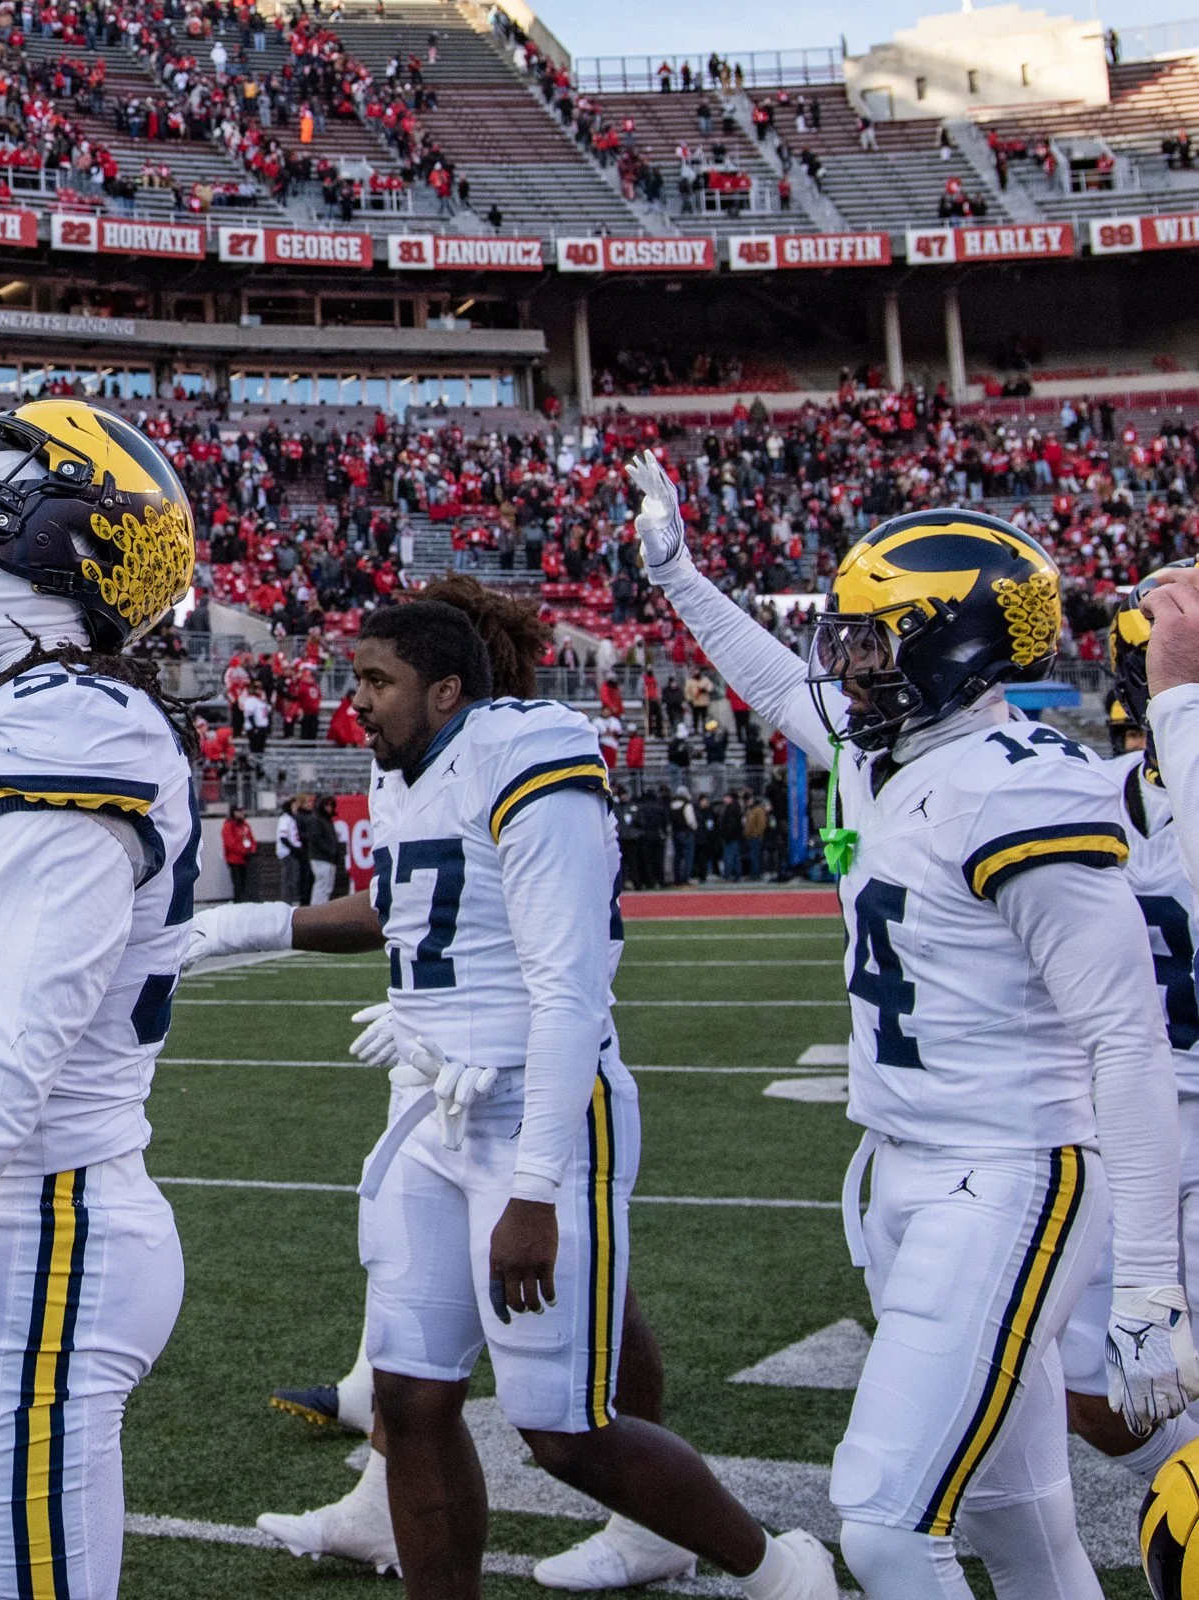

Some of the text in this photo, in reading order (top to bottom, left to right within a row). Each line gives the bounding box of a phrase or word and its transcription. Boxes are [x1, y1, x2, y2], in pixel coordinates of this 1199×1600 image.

[61, 221, 201, 254] 22 HORVATH
[228, 233, 363, 261] 27 GEORGE
[738, 236, 882, 263] 45 GRIFFIN
[916, 226, 1063, 257] 47 HARLEY
[436, 239, 543, 266] JANOWICZ
[565, 240, 707, 266] 40 CASSADY
[66, 317, 136, 335] LANDING
[85, 562, 100, 581] TED
[984, 727, 1090, 765] 14
[845, 876, 927, 1070] 4
